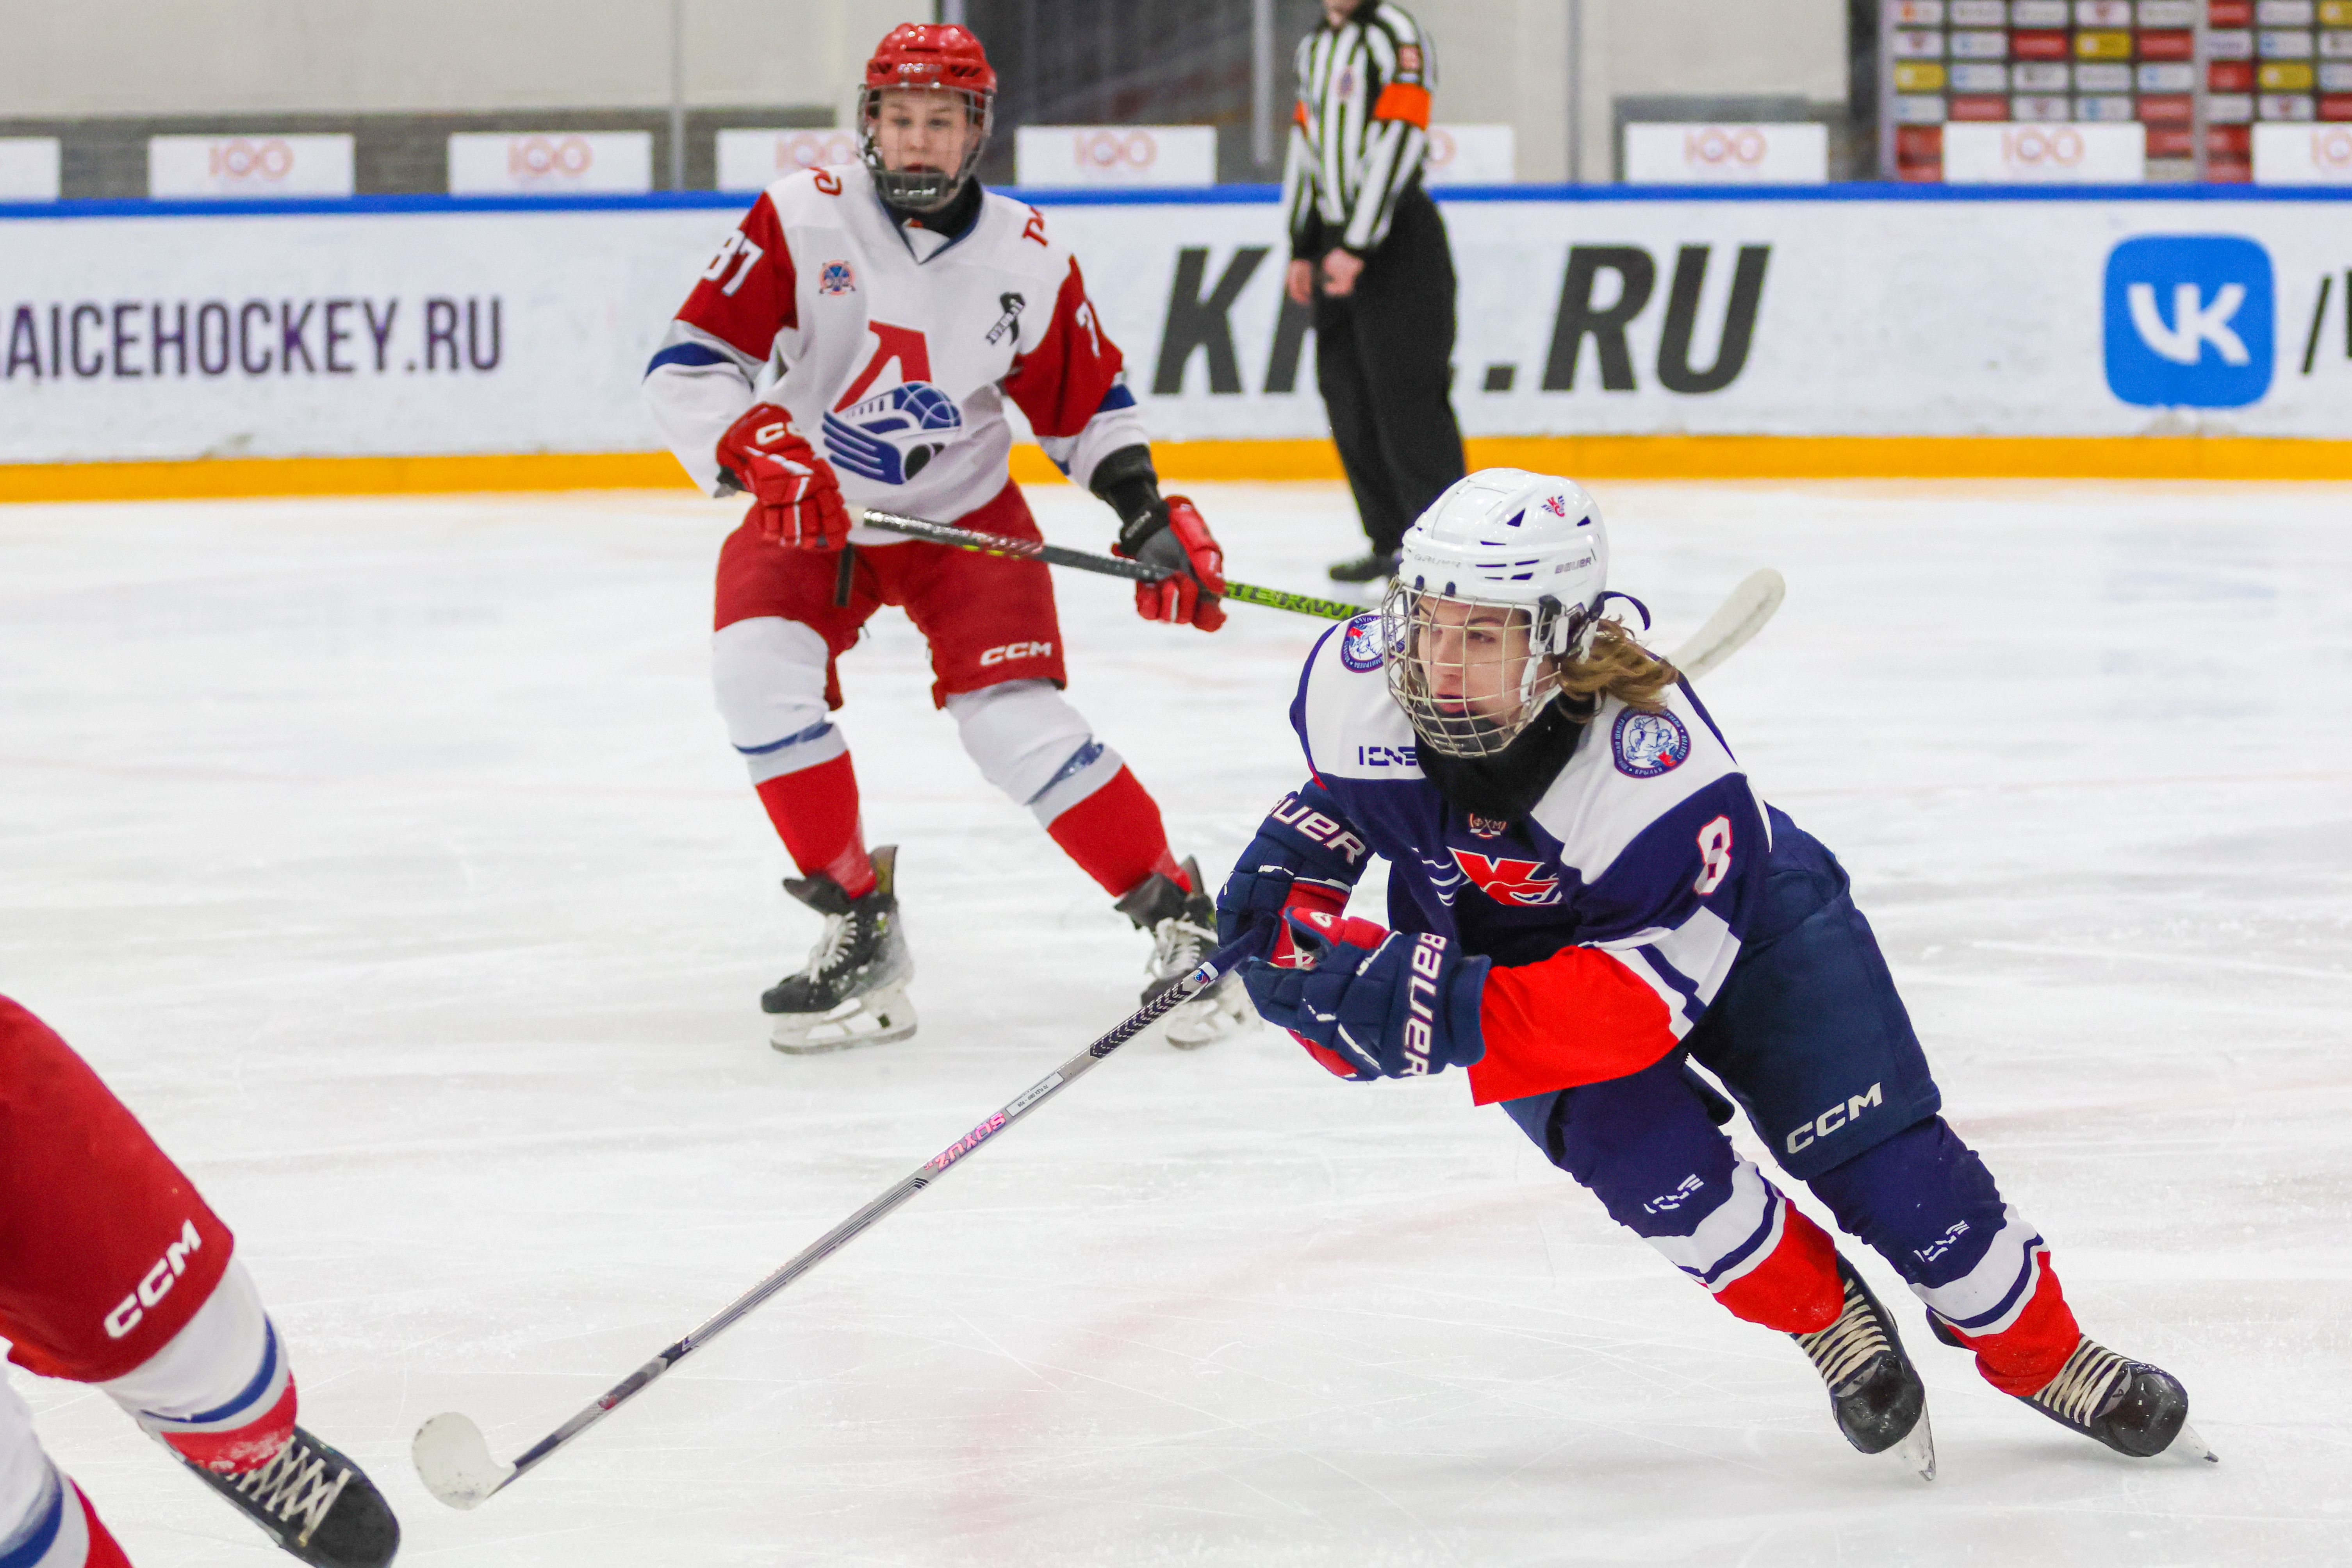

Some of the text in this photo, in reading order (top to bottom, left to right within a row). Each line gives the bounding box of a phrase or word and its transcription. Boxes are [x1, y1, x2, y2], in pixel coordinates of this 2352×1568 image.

[209, 138, 294, 180] 100
[508, 135, 593, 178] 100
[1074, 130, 1157, 170] 100
[1684, 127, 1767, 168] 100
[5, 299, 502, 377] AICEHOCKEY.RU
[1150, 244, 1771, 394] K.RU
[2127, 282, 2251, 366] VK
[980, 640, 1053, 666] CCM
[1693, 814, 1733, 895] 8
[1401, 931, 1447, 1076] BAUER
[1786, 1081, 1883, 1154] CCM
[103, 1219, 201, 1339] CCM
